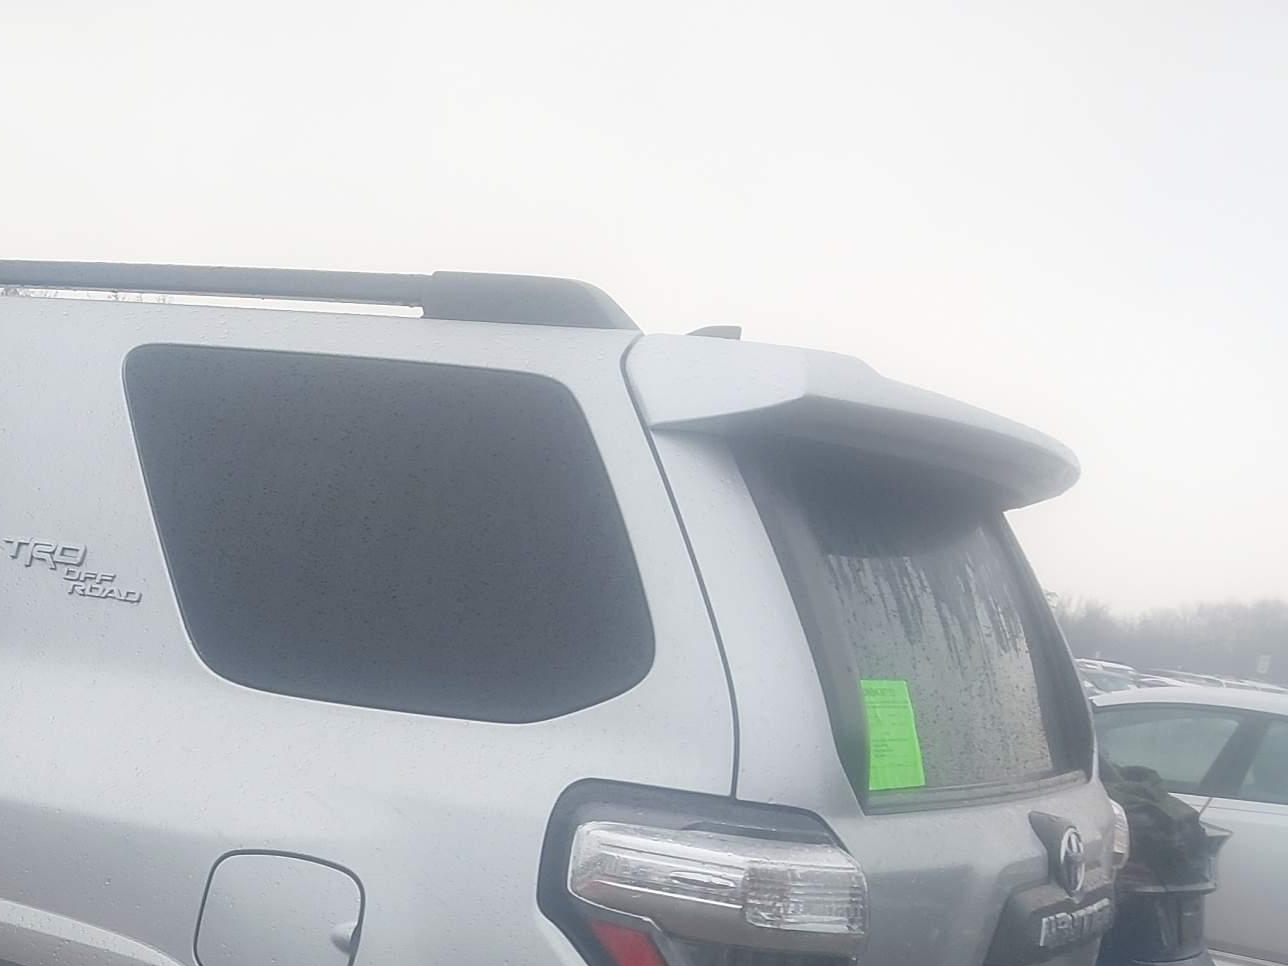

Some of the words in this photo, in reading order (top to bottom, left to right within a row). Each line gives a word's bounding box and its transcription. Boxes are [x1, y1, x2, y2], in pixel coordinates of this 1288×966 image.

[3, 537, 87, 570] TRD
[63, 567, 117, 584] OFF
[68, 581, 143, 604] ROAD
